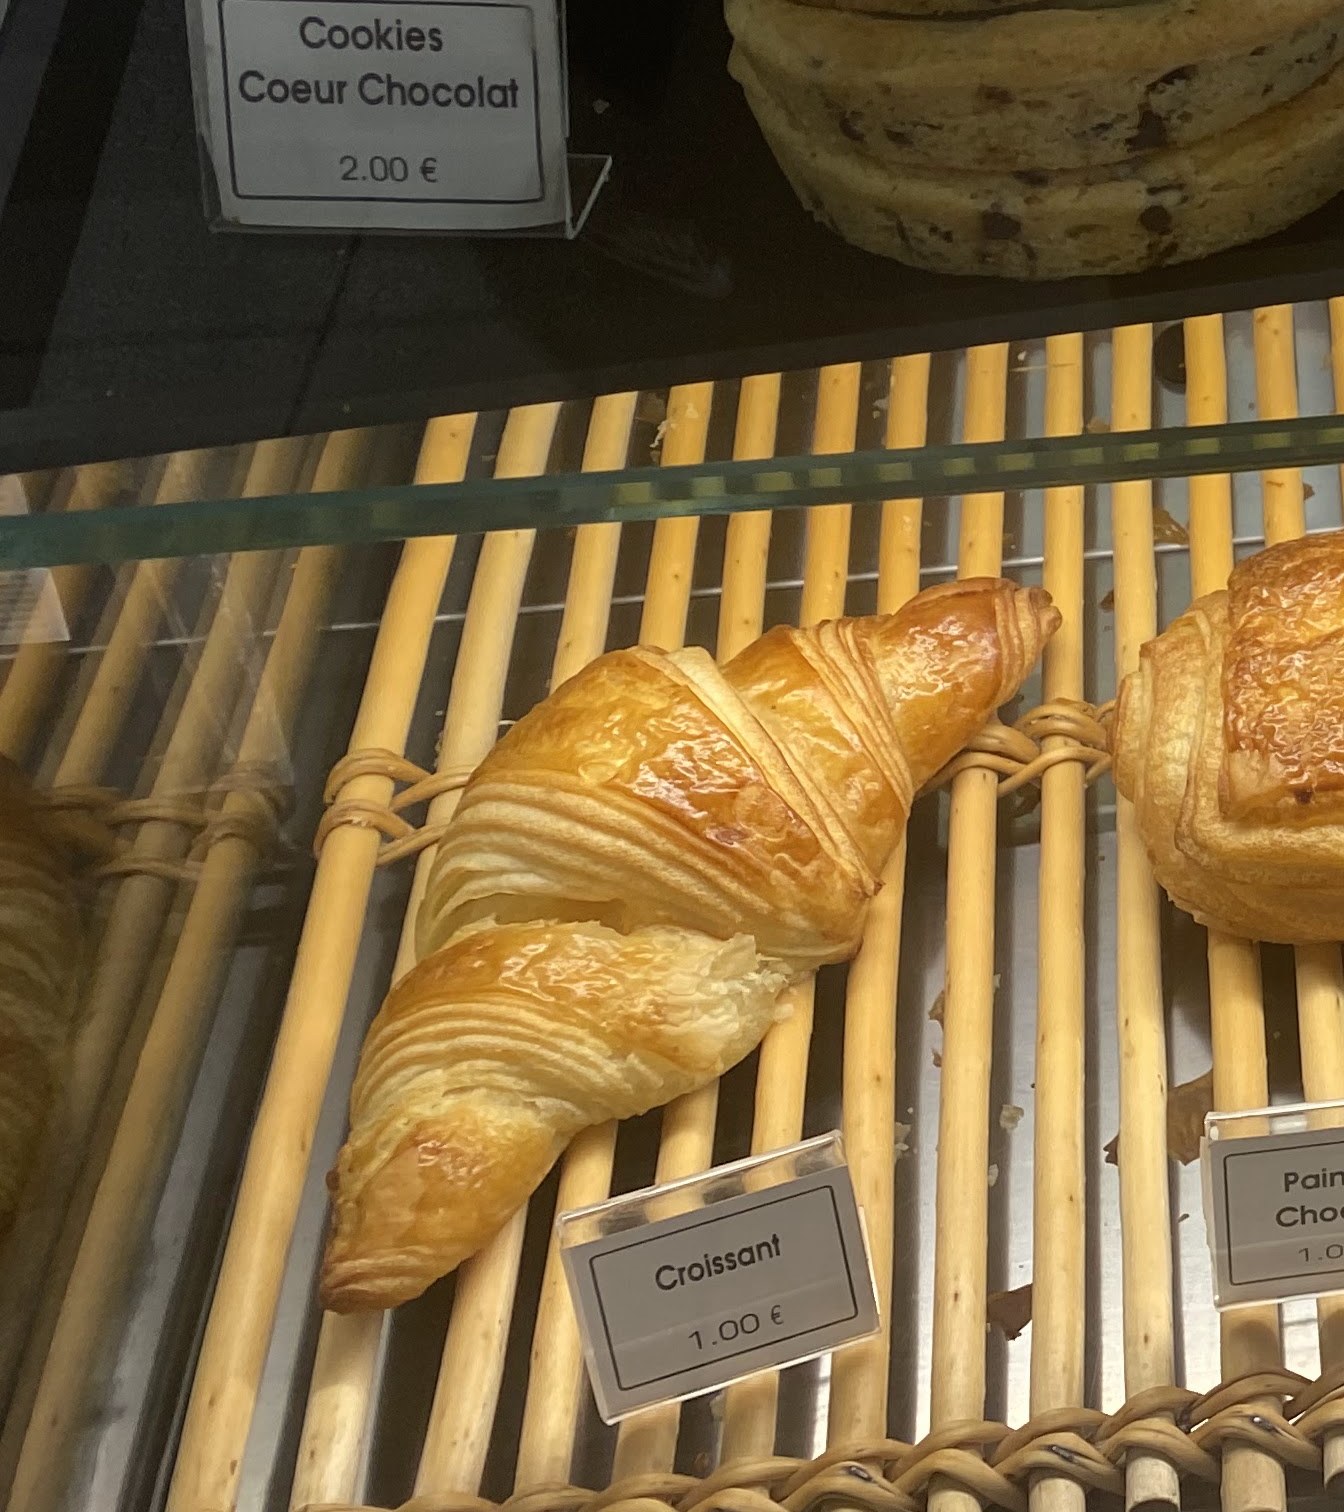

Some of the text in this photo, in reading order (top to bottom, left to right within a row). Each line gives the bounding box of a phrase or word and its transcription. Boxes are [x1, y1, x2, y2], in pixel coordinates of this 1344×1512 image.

[300, 16, 444, 52] Cookies
[238, 69, 520, 109] Coeur Chocolat
[339, 155, 438, 184] 2.00 €
[655, 1233, 782, 1290] Croissant
[688, 1304, 784, 1350] 1.00 €
